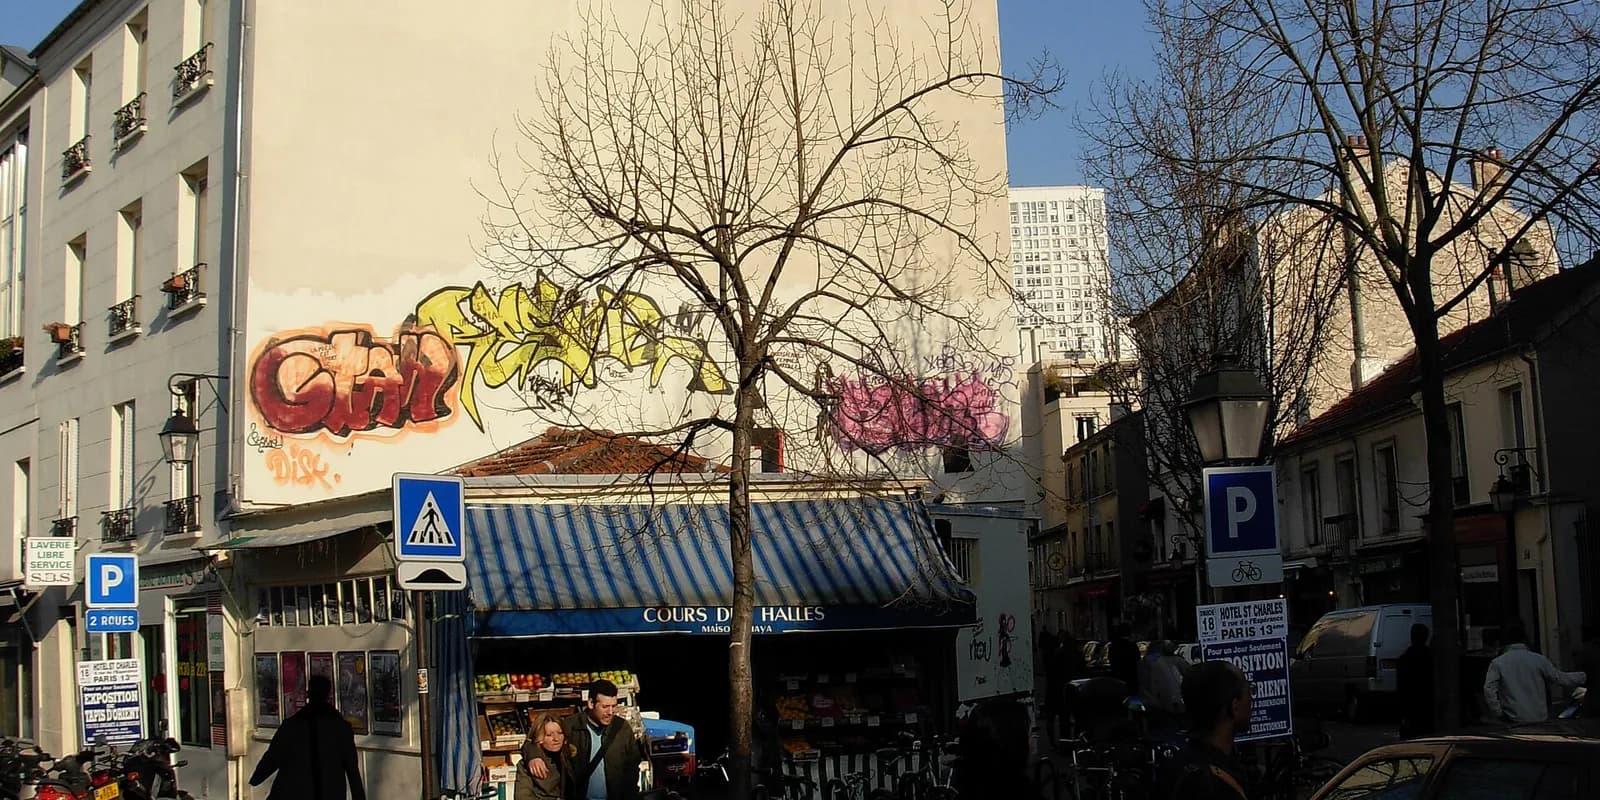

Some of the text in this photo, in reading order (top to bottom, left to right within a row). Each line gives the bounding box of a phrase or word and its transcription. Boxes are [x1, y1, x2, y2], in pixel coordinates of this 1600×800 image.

[1227, 486, 1257, 538] P
[30, 541, 71, 549] LAVERIE
[37, 551, 65, 559] LIBRE
[30, 561, 72, 569] SERVICE
[101, 564, 123, 597] P
[643, 607, 708, 622] COURS
[762, 606, 825, 622] HALLES
[1220, 606, 1243, 620] HOTEL
[1243, 606, 1252, 618] ST
[1253, 602, 1283, 617] CHARLES
[89, 615, 135, 626] 2 ROUES
[1203, 617, 1215, 631] 18
[1221, 627, 1256, 640] PARIS
[1207, 648, 1222, 656] Pour
[1249, 643, 1281, 652] Seulement
[93, 663, 108, 671] HOTEL
[116, 661, 138, 669] CHARLES
[84, 691, 138, 705] EXPOSITION
[85, 709, 106, 722] TAPIS
